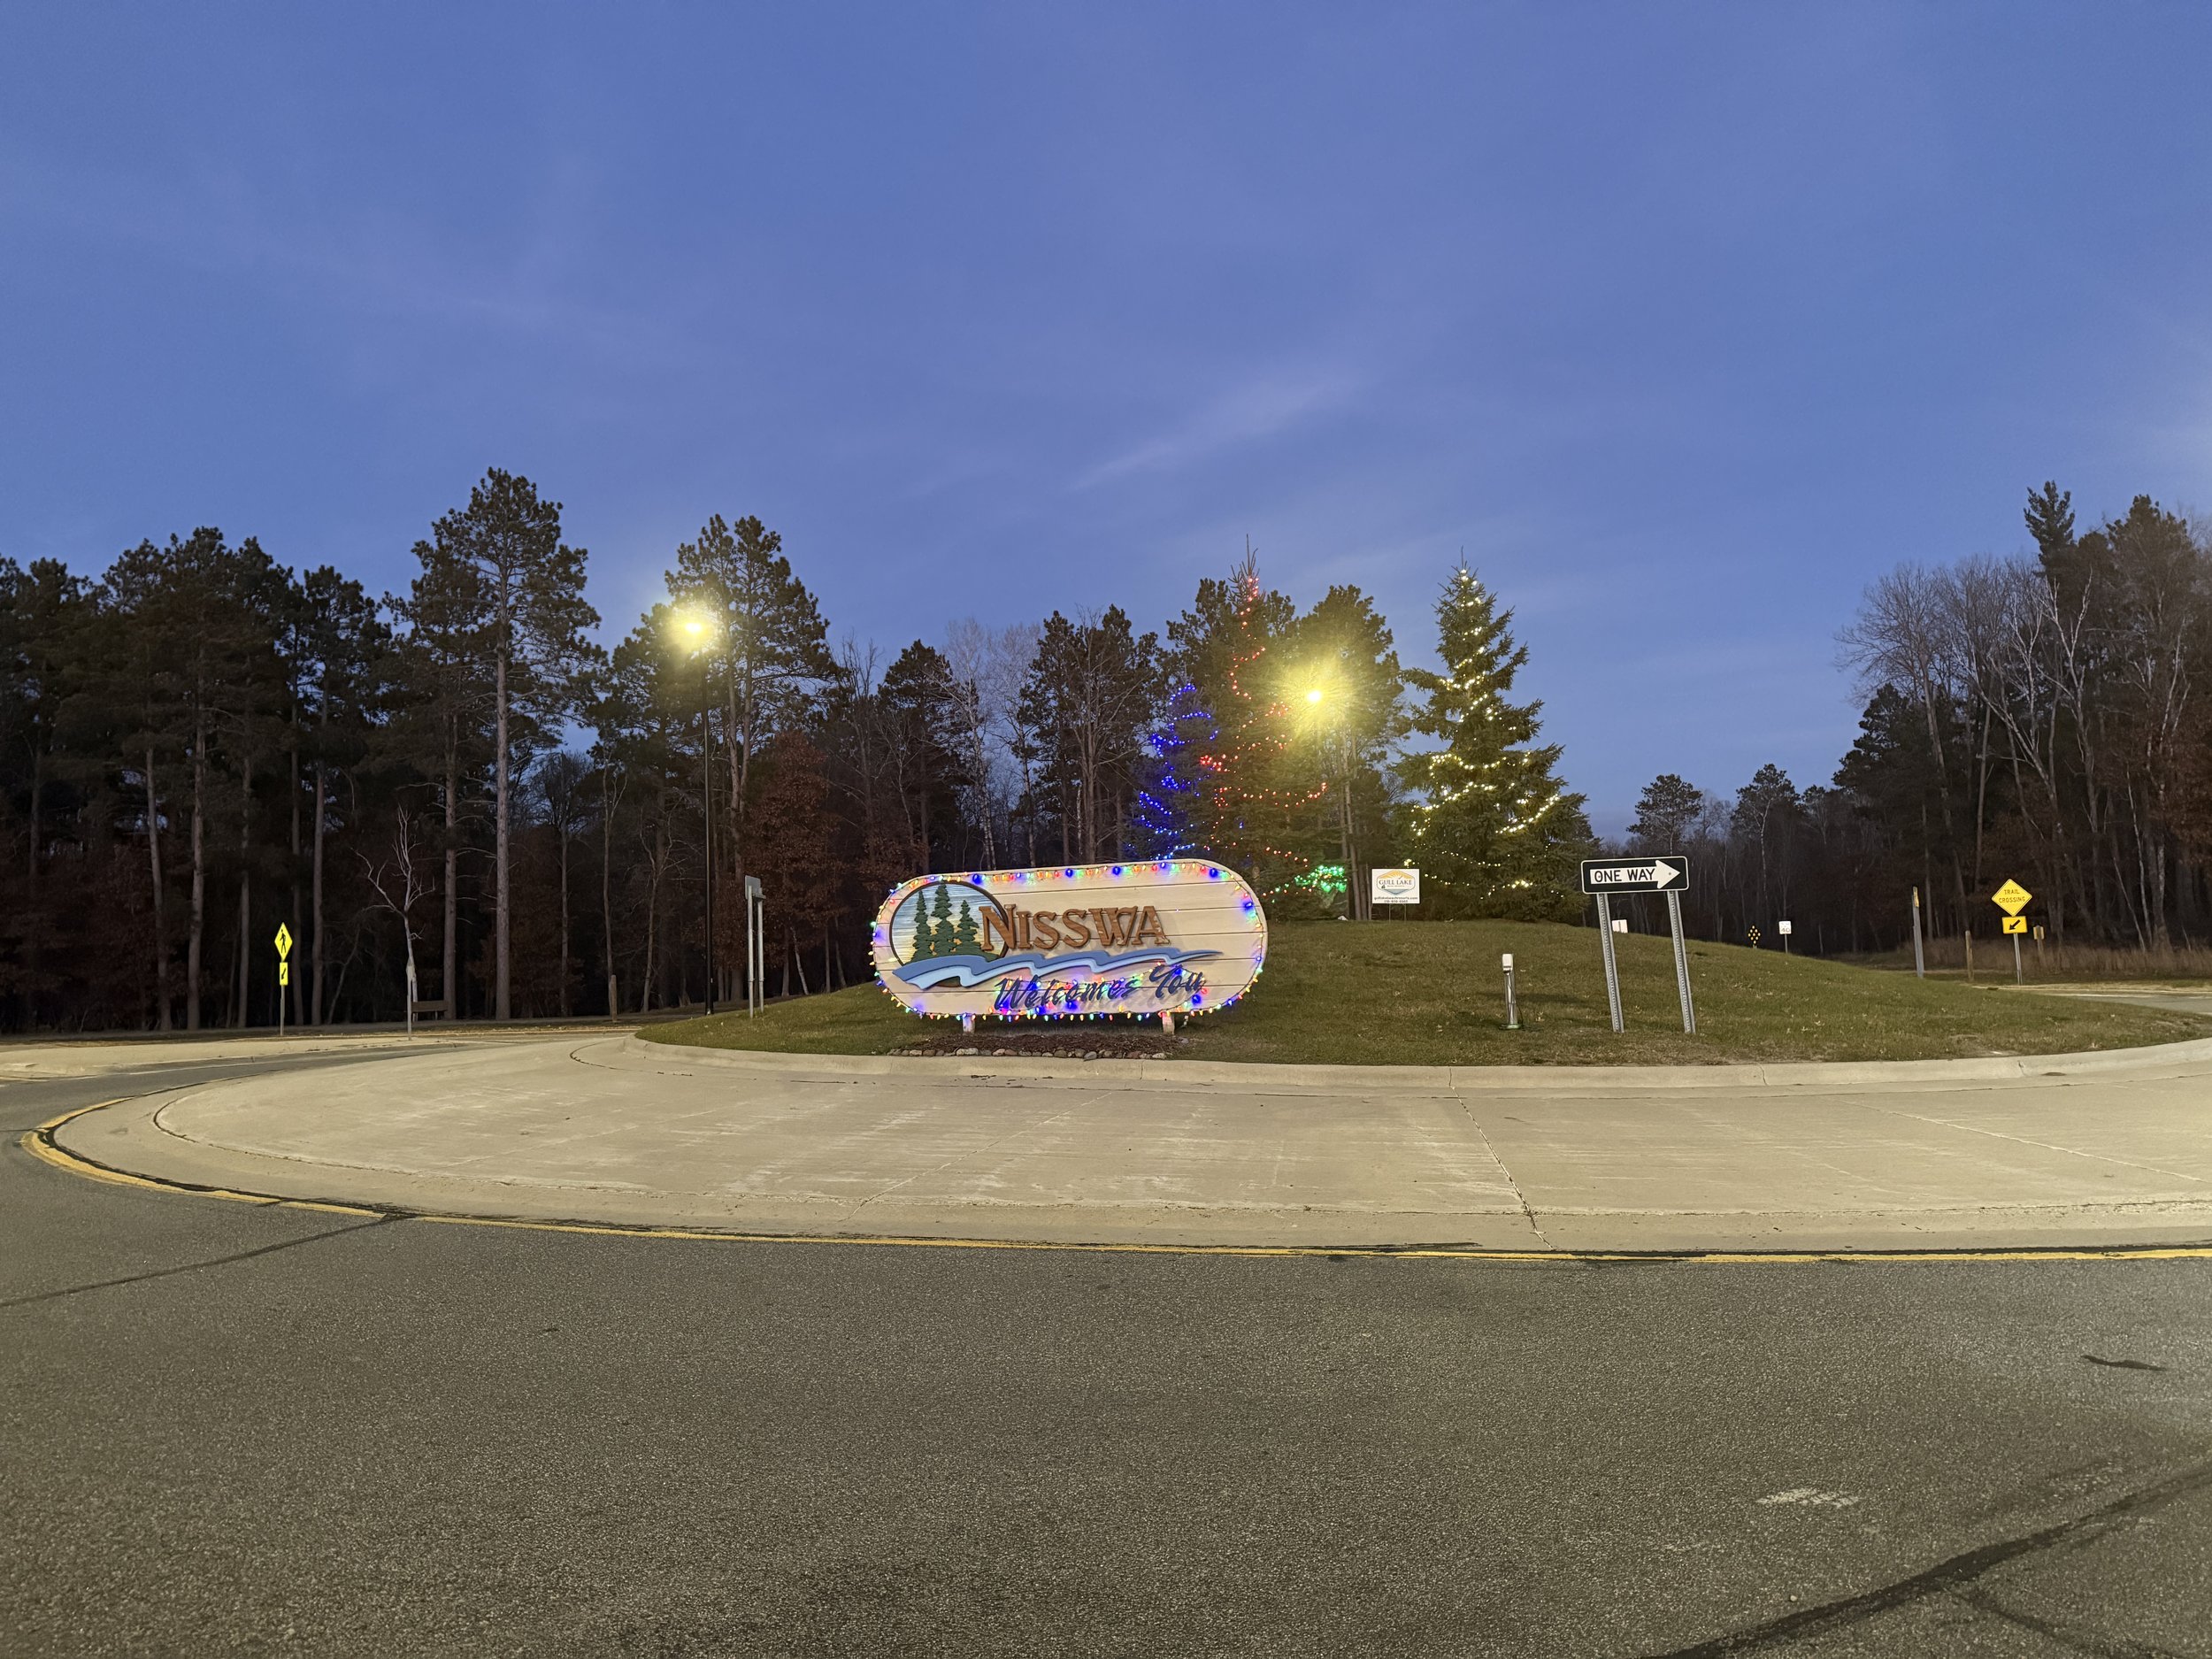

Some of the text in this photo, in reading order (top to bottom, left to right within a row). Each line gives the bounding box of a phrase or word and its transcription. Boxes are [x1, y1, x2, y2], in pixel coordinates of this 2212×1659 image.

[1594, 868, 1655, 882] ONE WAY
[994, 964, 1204, 1010] Welcomes You
